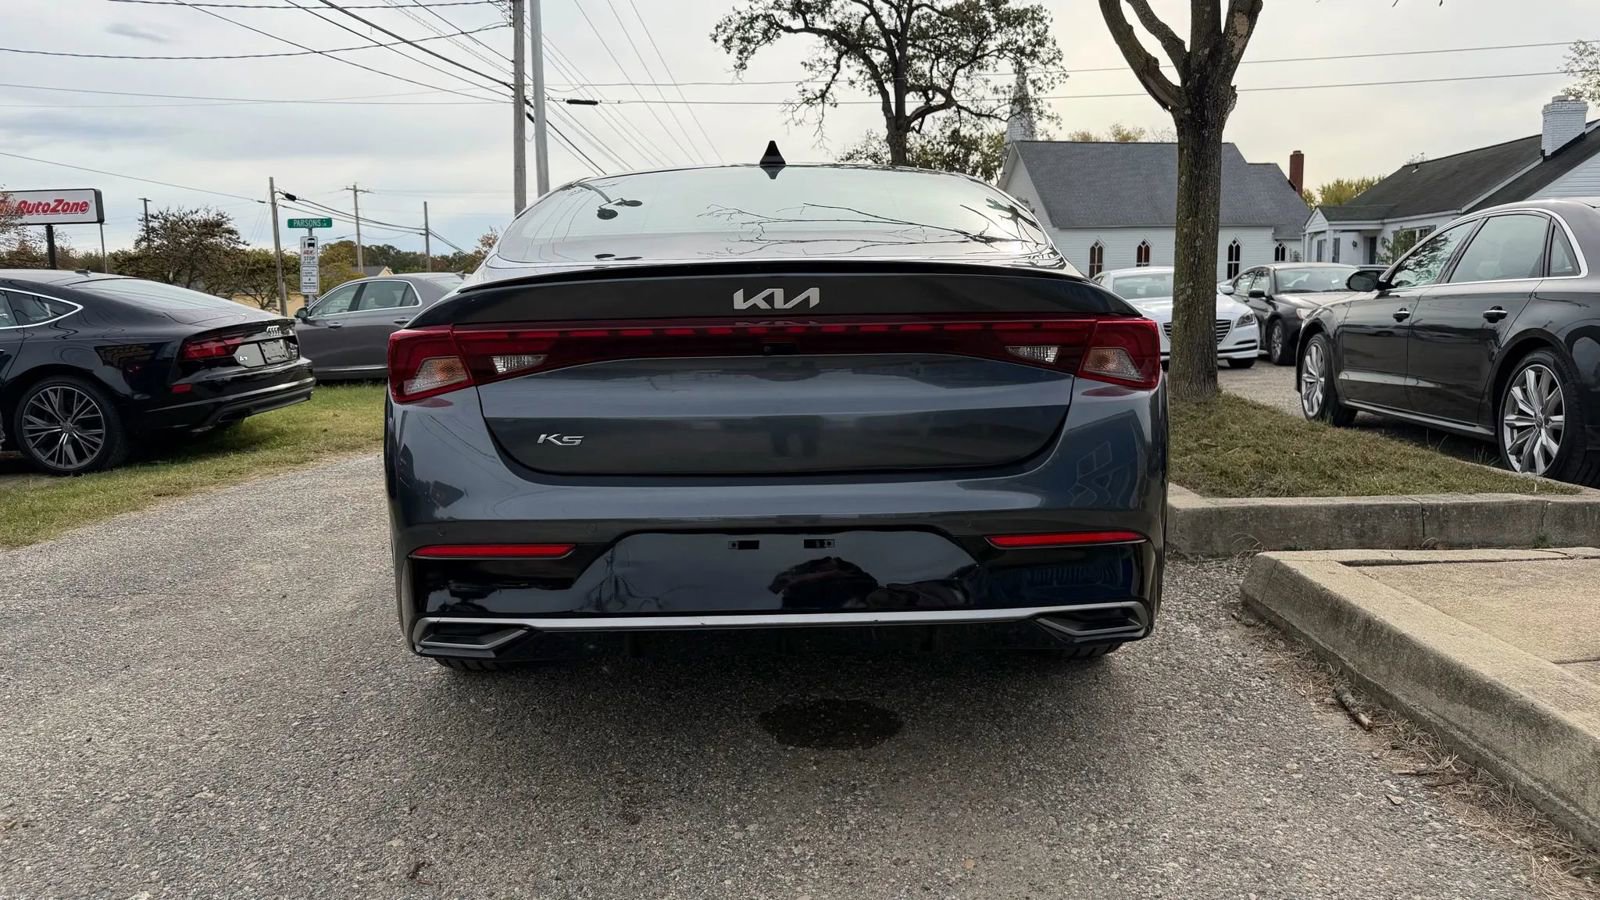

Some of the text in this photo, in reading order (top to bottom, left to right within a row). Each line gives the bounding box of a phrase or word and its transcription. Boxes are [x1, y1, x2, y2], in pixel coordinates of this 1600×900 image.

[17, 199, 89, 215] AutoZone
[293, 219, 321, 227] PARSONS
[733, 287, 820, 310] KIA
[537, 433, 584, 446] K5
